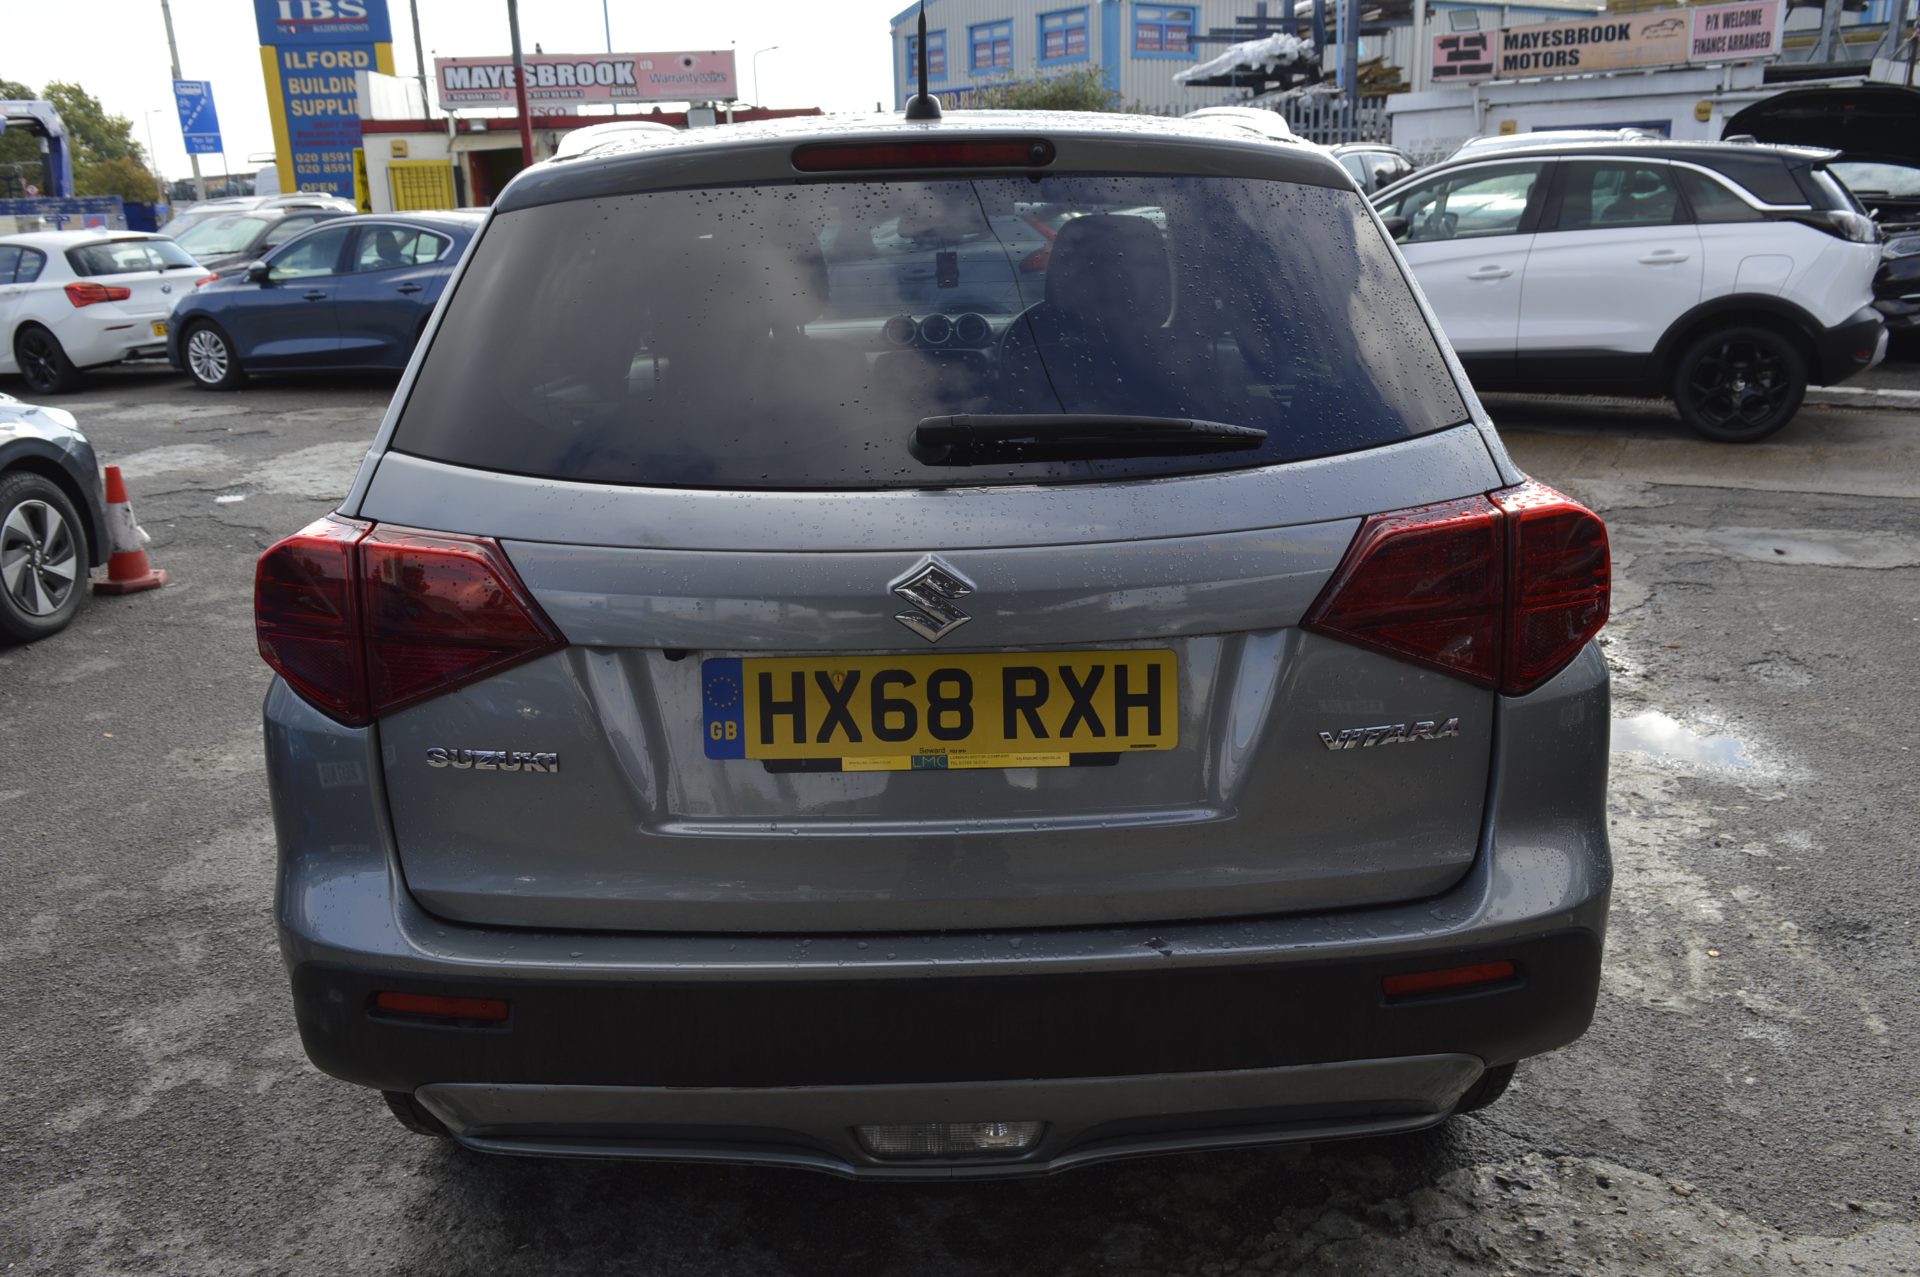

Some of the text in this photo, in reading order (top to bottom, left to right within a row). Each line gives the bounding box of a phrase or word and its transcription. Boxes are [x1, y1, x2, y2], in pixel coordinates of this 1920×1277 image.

[278, 0, 367, 20] IBS
[1705, 8, 1763, 31] P/X WELCOME
[1503, 22, 1632, 51] MAYESBROOK
[1693, 36, 1726, 55] FINANCE
[1727, 32, 1771, 52] ARRANGED
[285, 51, 368, 69] ILFORD
[1503, 49, 1580, 71] MOTORS
[443, 61, 637, 90] MAYESBROOK
[288, 77, 357, 94] BUILDIN
[610, 86, 639, 97] AUTOS
[291, 98, 358, 116] SUPPLI
[295, 152, 350, 163] 020 8591
[297, 163, 352, 174] 020 8591
[301, 182, 338, 192] OPEN
[758, 664, 1162, 744] HX68 RXH
[710, 721, 738, 740] GB
[1319, 717, 1460, 751] VITARA
[426, 747, 560, 773] SUZUKI
[912, 755, 948, 768] LMC
